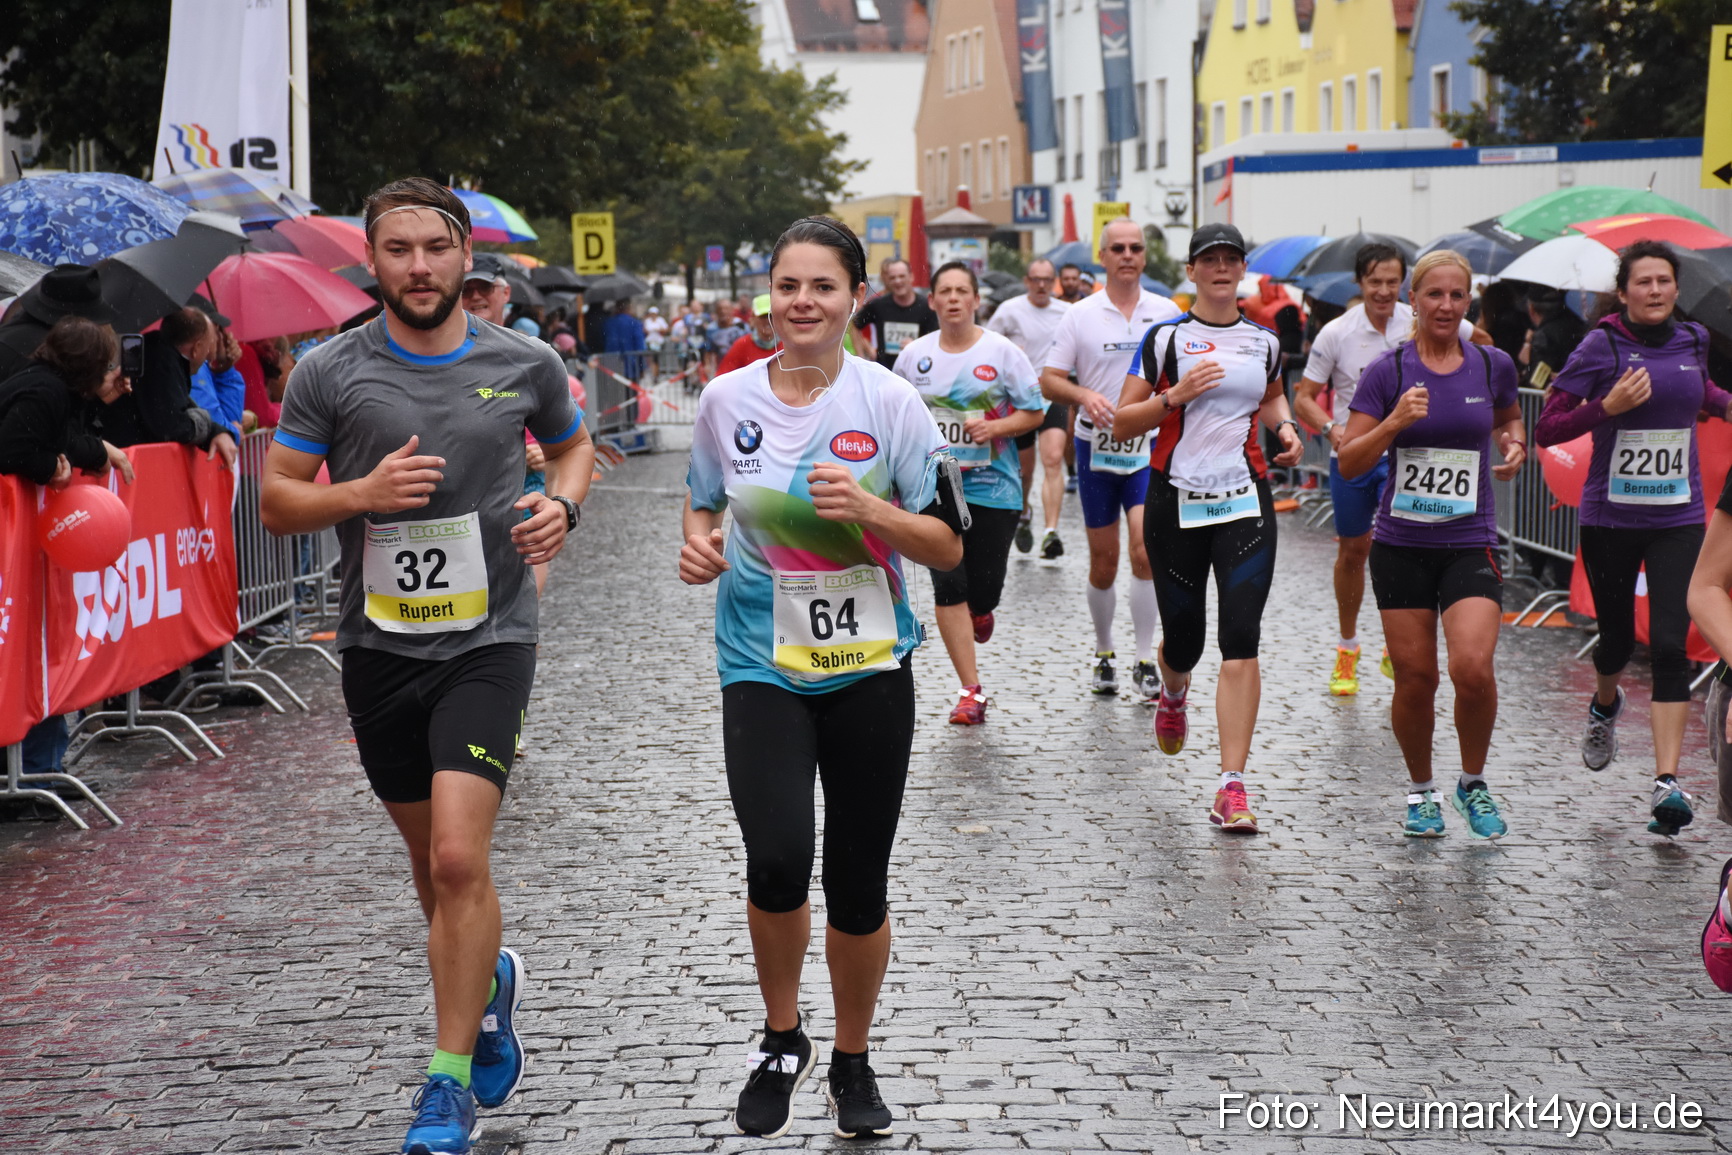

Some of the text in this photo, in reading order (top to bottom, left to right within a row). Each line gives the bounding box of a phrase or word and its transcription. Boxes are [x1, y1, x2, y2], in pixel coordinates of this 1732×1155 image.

[577, 216, 607, 227] Block
[585, 232, 604, 260] D
[1185, 341, 1208, 349] tkn
[837, 438, 874, 454] Hervis
[1104, 456, 1137, 468] Matthias
[1434, 451, 1473, 463] BOCK
[1618, 447, 1684, 476] 2204
[1403, 464, 1471, 497] 2426
[1206, 506, 1232, 517] Hana
[1412, 499, 1454, 515] Kristina
[408, 520, 470, 539] BOCK
[395, 548, 449, 592] 32
[824, 569, 877, 588] BOCK
[399, 601, 454, 621] Rupert
[809, 597, 859, 641] 64
[811, 650, 865, 669] Sabine
